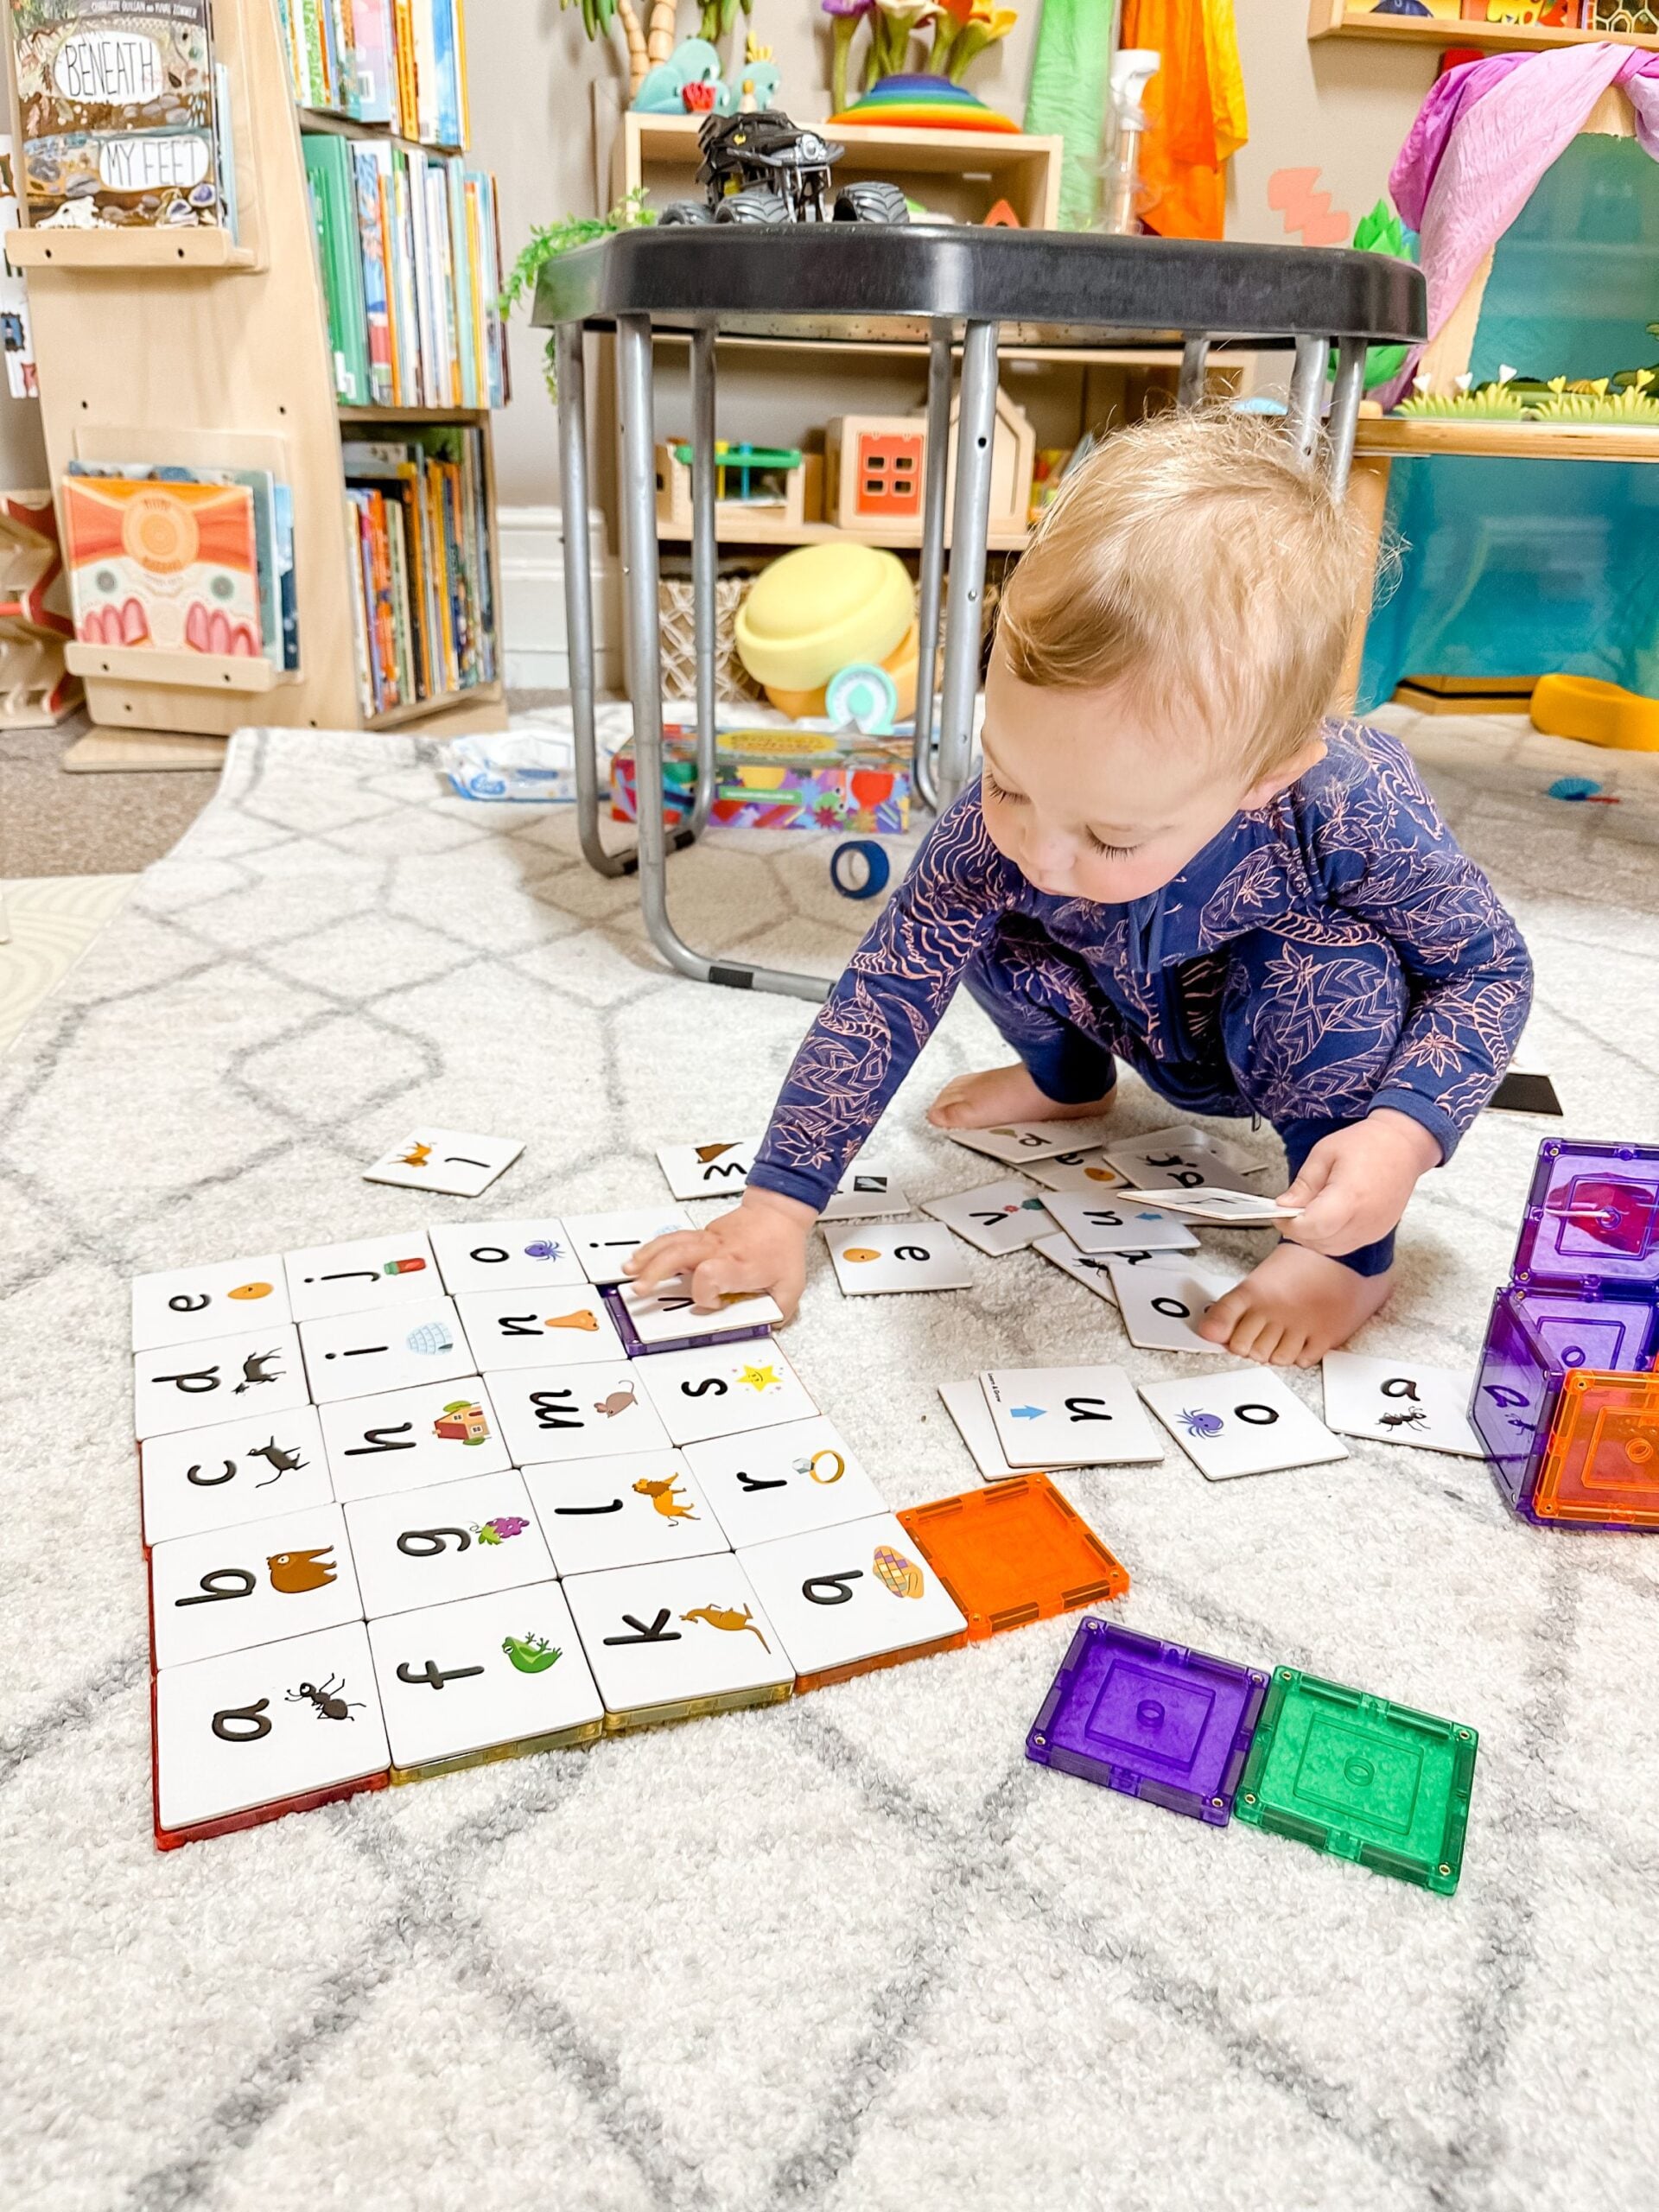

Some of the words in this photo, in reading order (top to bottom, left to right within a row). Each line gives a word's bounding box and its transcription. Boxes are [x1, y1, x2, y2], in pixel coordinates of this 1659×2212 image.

[66, 41, 155, 97] BENEATH
[106, 142, 134, 187] MY
[143, 140, 198, 186] FEET
[969, 1212, 1007, 1225] v
[470, 1248, 509, 1262] o
[894, 1247, 930, 1261] e
[304, 1272, 379, 1282] j
[168, 1294, 212, 1312] e
[1151, 1298, 1190, 1318] o
[499, 1315, 543, 1335] n
[326, 1347, 388, 1359] i
[152, 1366, 219, 1393] d
[682, 1379, 728, 1396] s
[1382, 1379, 1421, 1401] a
[530, 1389, 584, 1428] m
[1235, 1405, 1279, 1425] o
[345, 1422, 416, 1455] h
[188, 1460, 236, 1485] c
[737, 1472, 787, 1491] r
[555, 1499, 623, 1515] l
[397, 1529, 471, 1556] g
[175, 1569, 256, 1606] b
[802, 1571, 863, 1605] q
[602, 1608, 682, 1646] k
[397, 1661, 484, 1689] f
[212, 1699, 271, 1742] a
